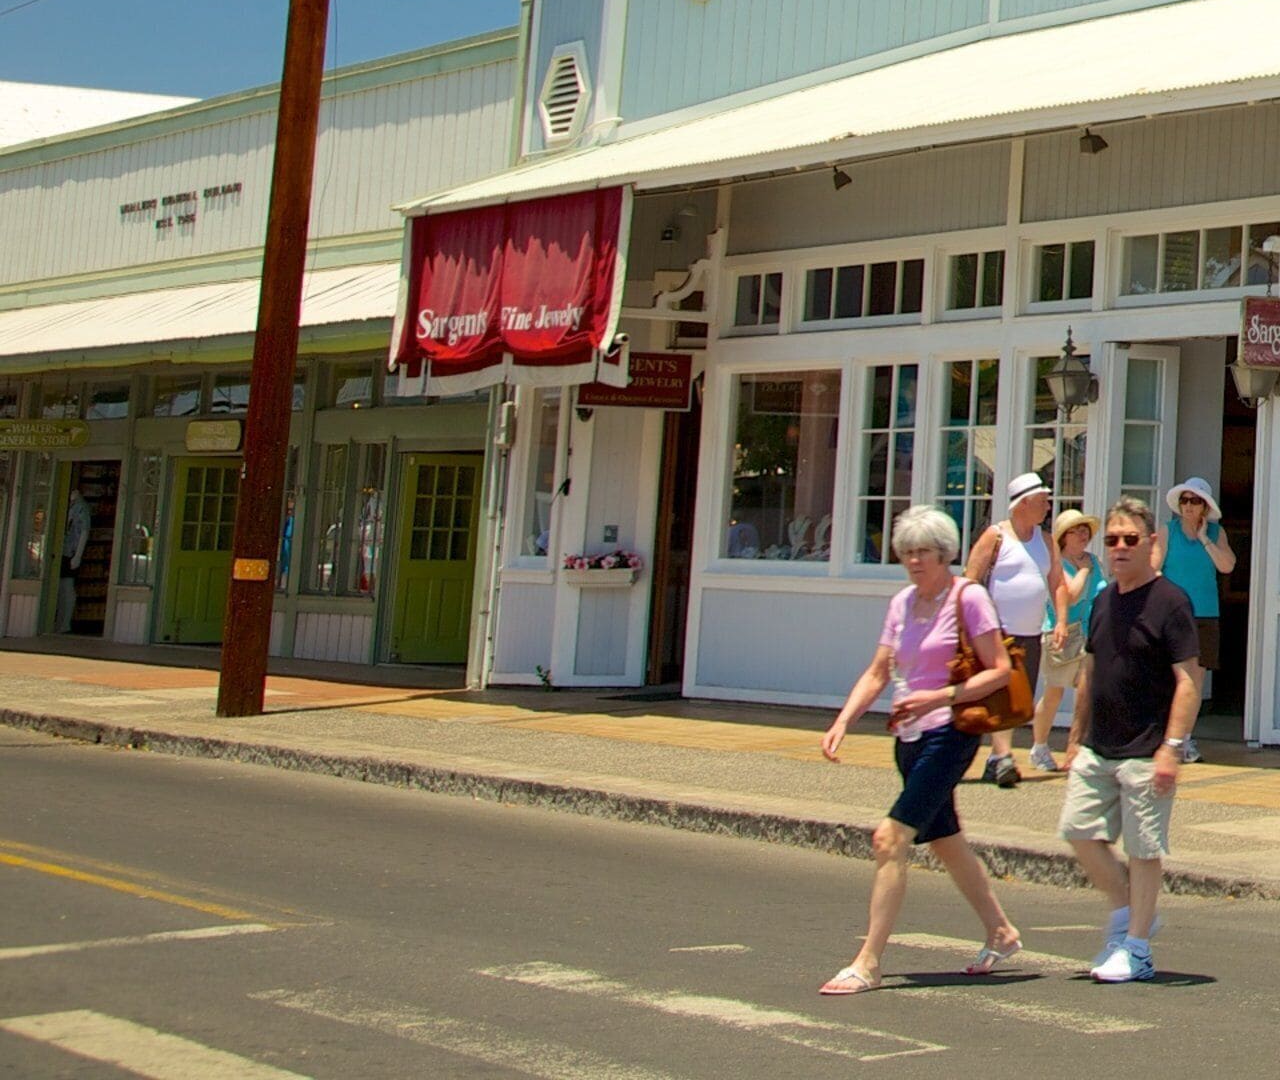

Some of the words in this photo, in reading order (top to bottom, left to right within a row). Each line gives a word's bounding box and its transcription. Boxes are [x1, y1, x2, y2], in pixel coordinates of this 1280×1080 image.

[501, 306, 533, 330] Fine
[534, 302, 584, 331] Jewelry
[629, 358, 678, 373] GENT'S
[12, 423, 57, 434] WHALERS
